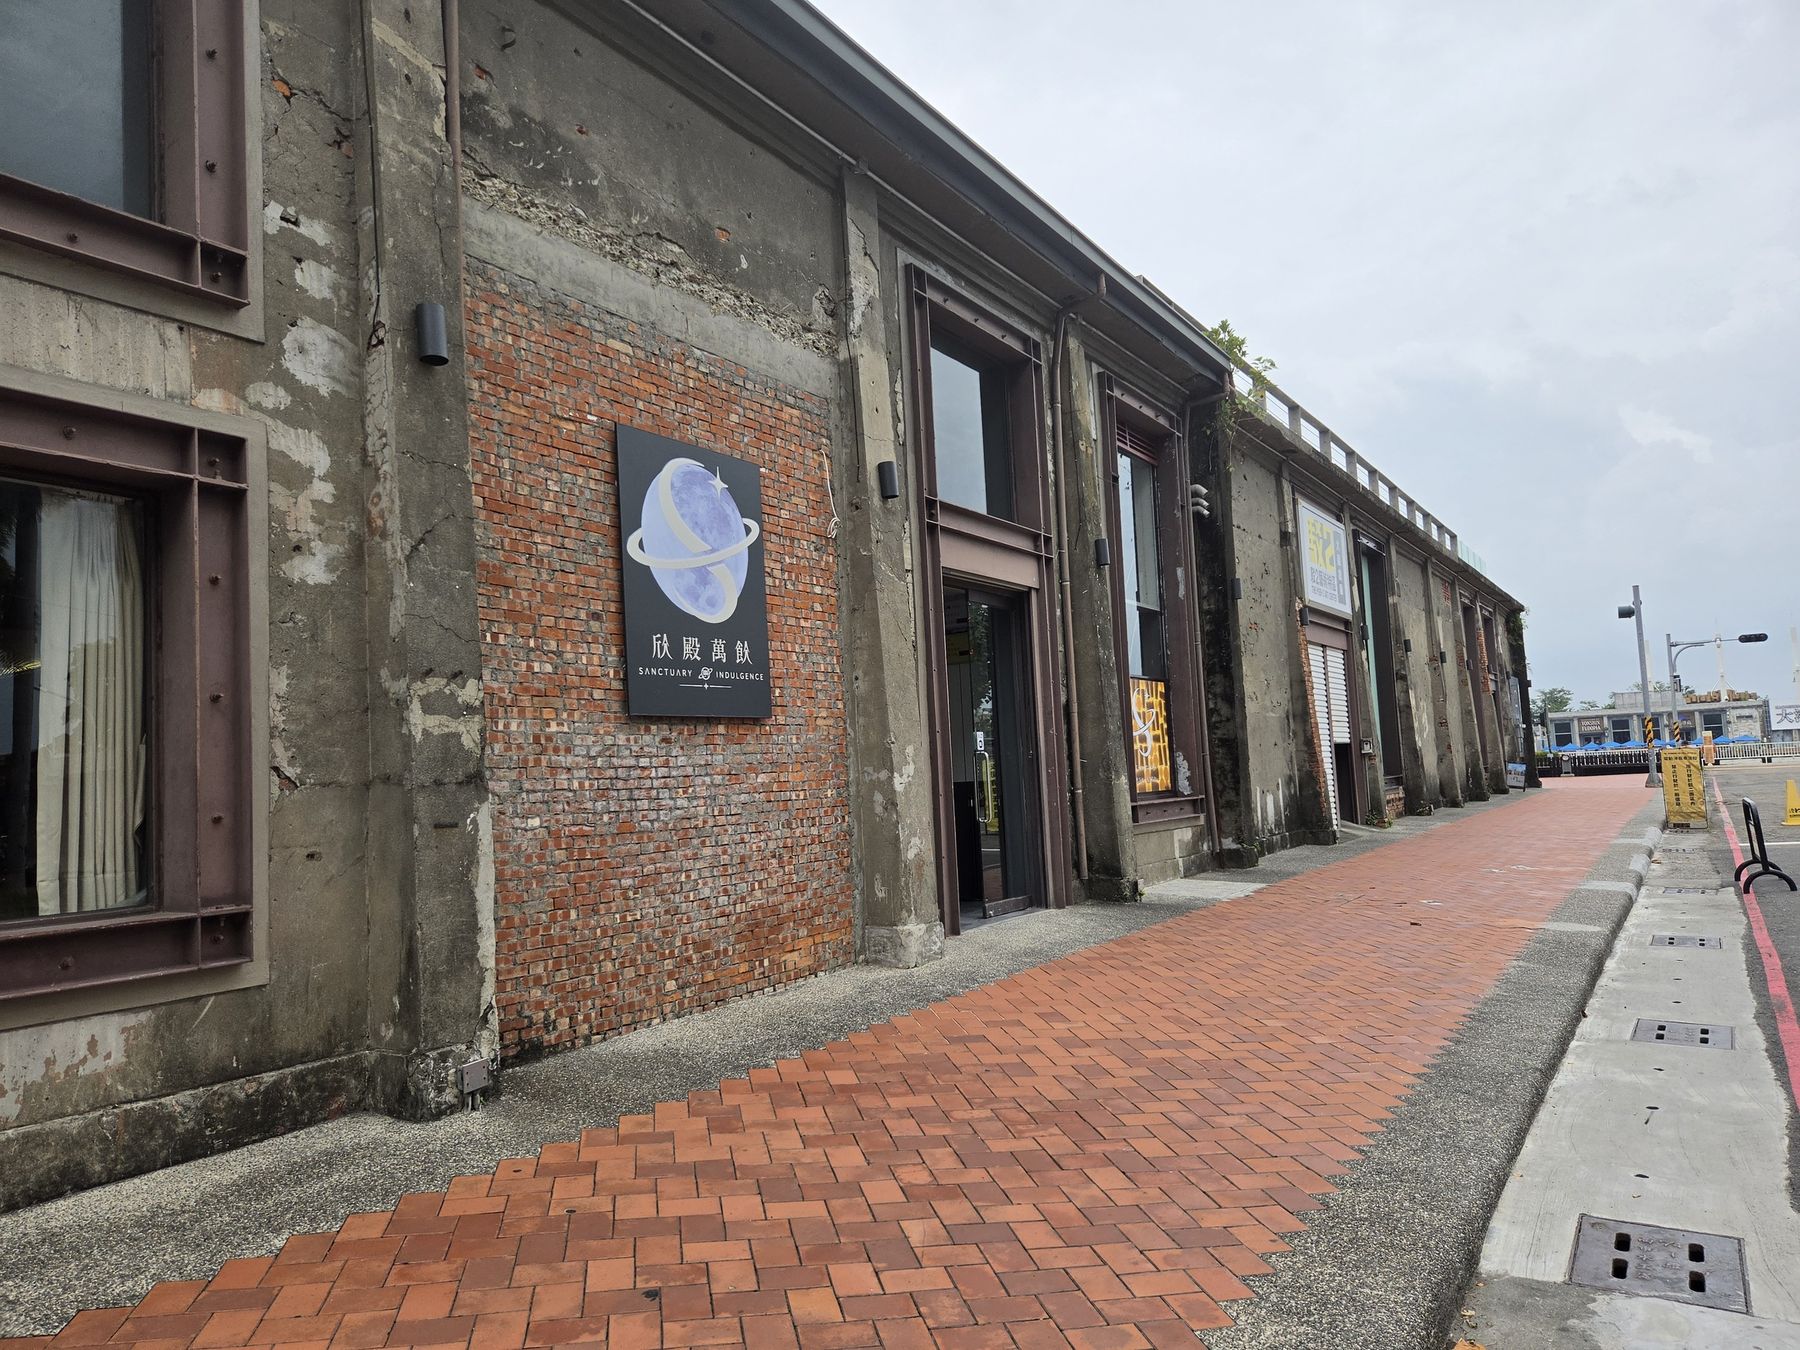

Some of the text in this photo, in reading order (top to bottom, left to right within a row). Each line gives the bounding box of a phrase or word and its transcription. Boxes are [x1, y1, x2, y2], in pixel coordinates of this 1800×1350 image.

[652, 633, 753, 665] 欣殿萬飲
[638, 667, 764, 681] SANCTUARY INDULGENCE
